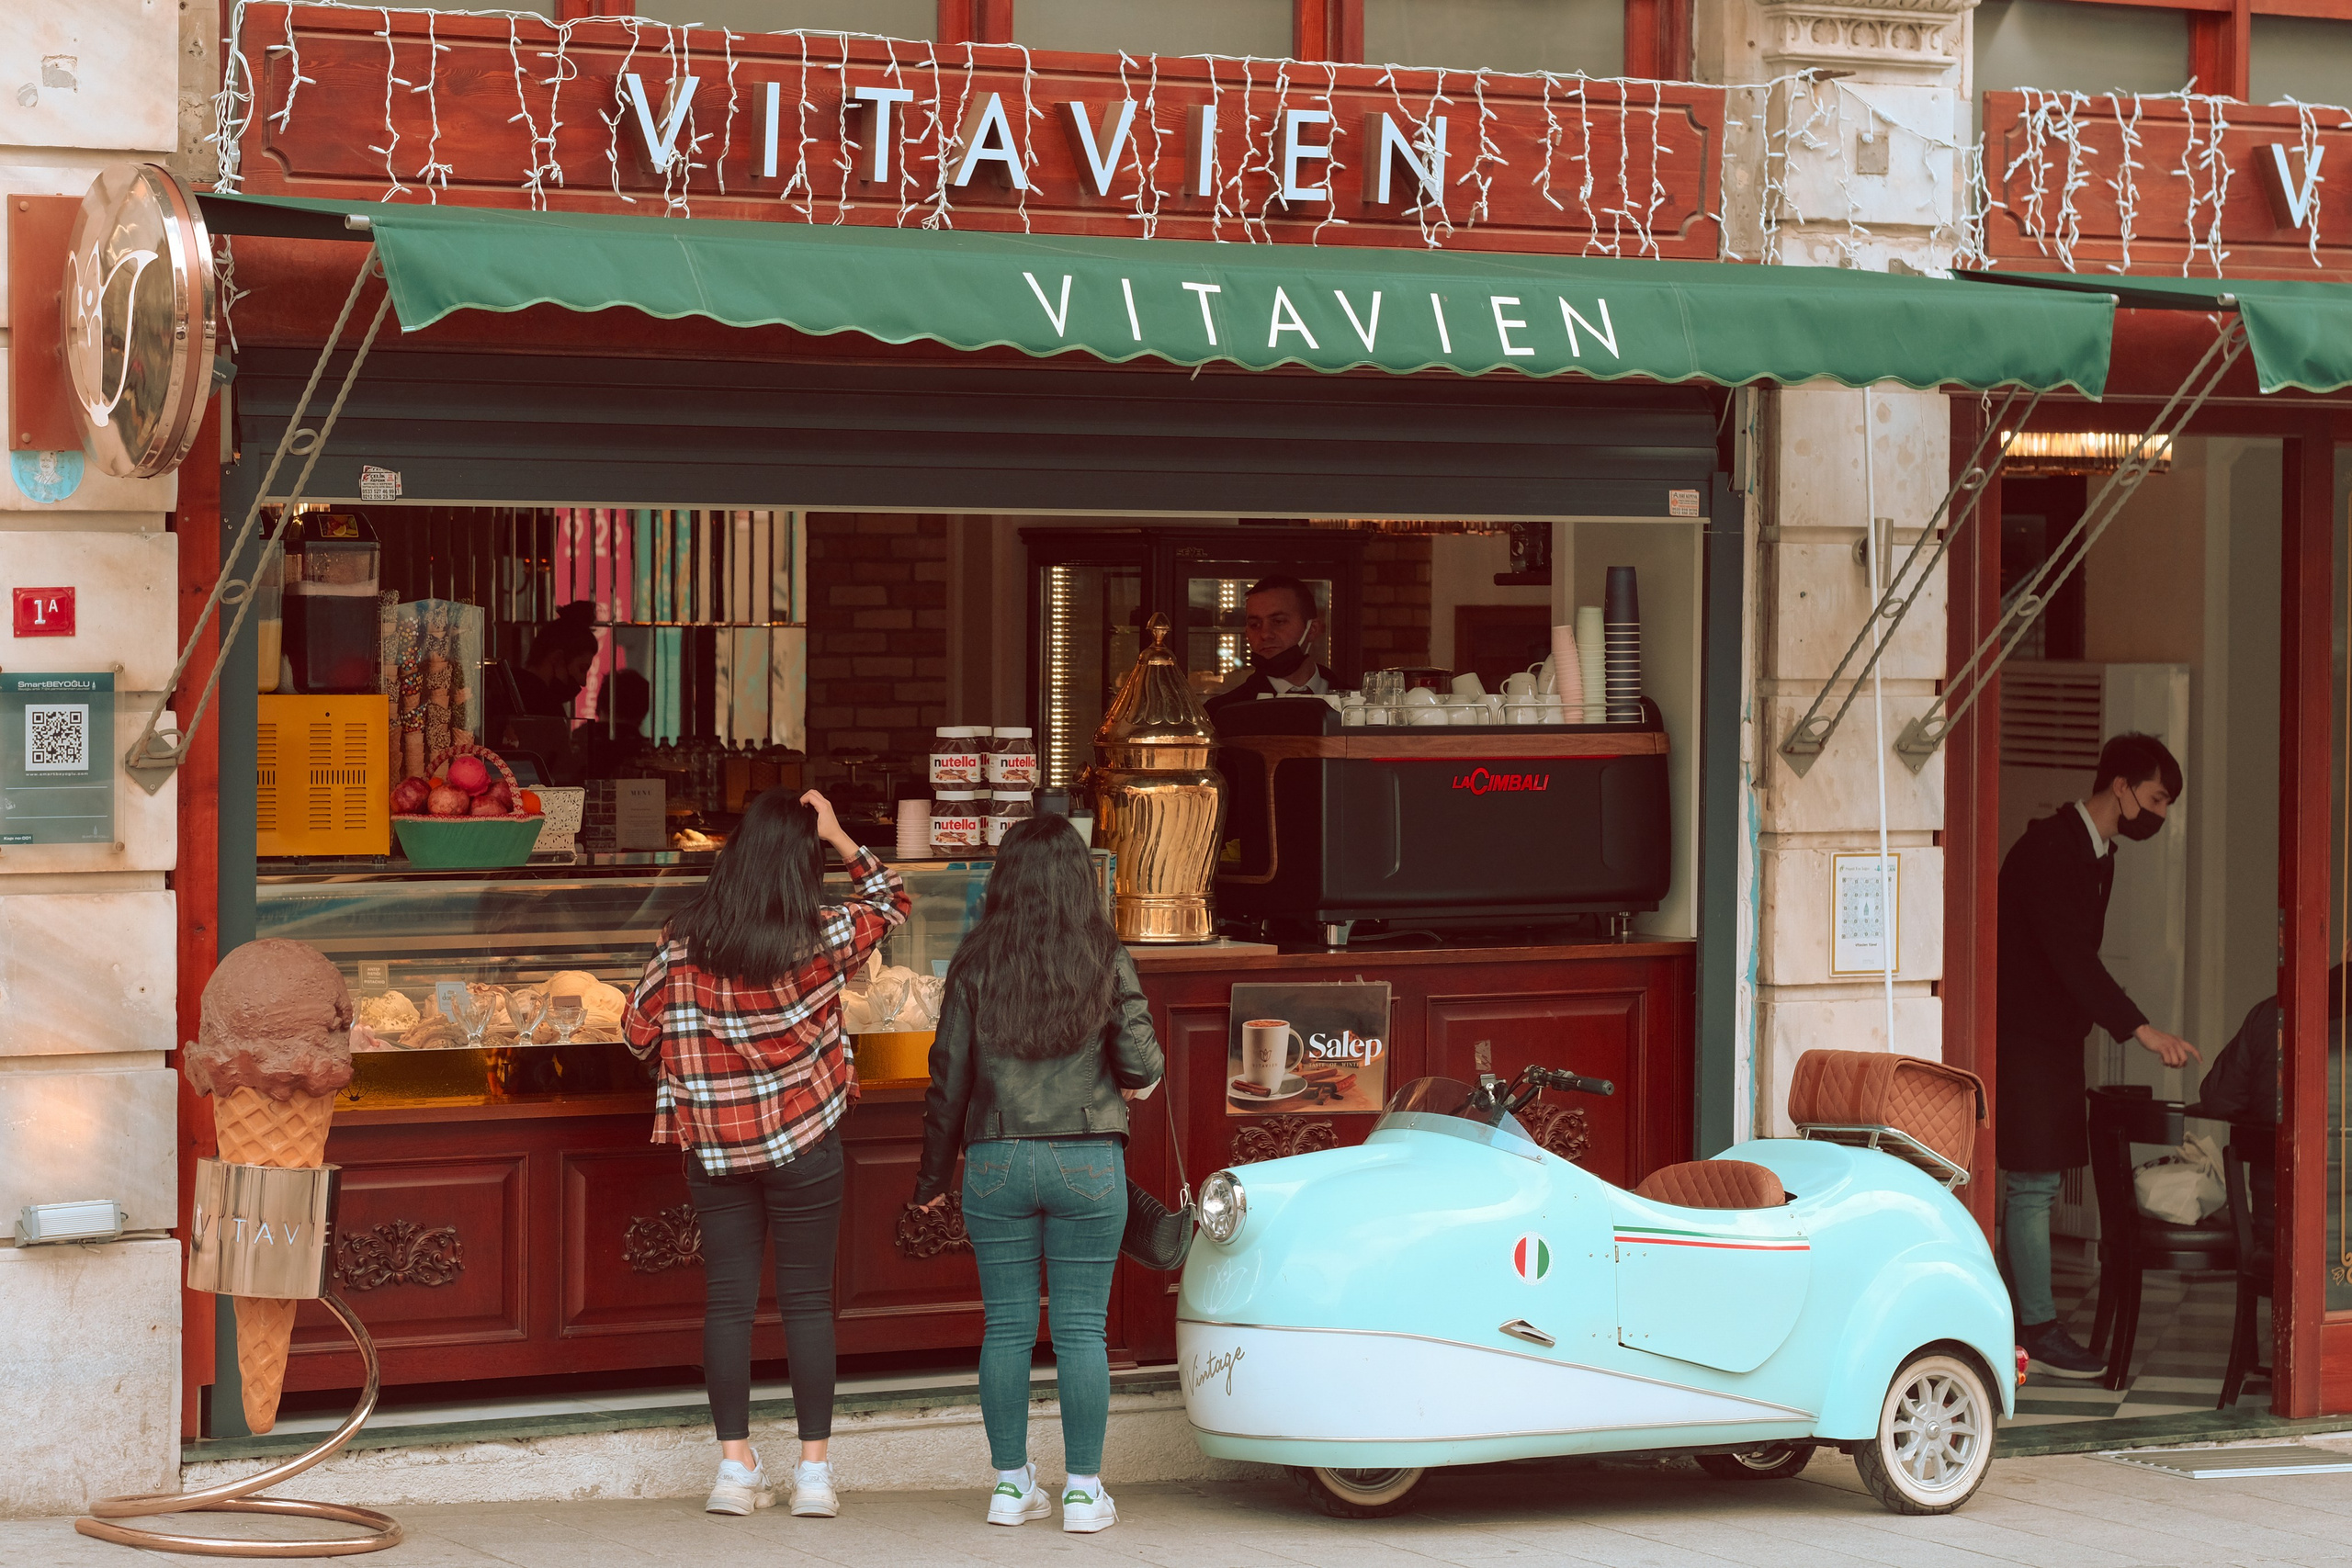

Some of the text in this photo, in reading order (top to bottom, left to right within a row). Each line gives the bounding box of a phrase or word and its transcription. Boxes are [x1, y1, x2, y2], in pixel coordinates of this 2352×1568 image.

[625, 73, 1447, 204] VITAVIEN
[1023, 272, 1619, 359] VITAVIEN
[934, 756, 976, 767] nutella
[1001, 756, 1035, 767] nutella
[1470, 768, 1550, 795] CIMBALI
[934, 818, 976, 829] nutella
[1309, 1031, 1382, 1066] Salep
[1186, 1347, 1245, 1396] Vintage
